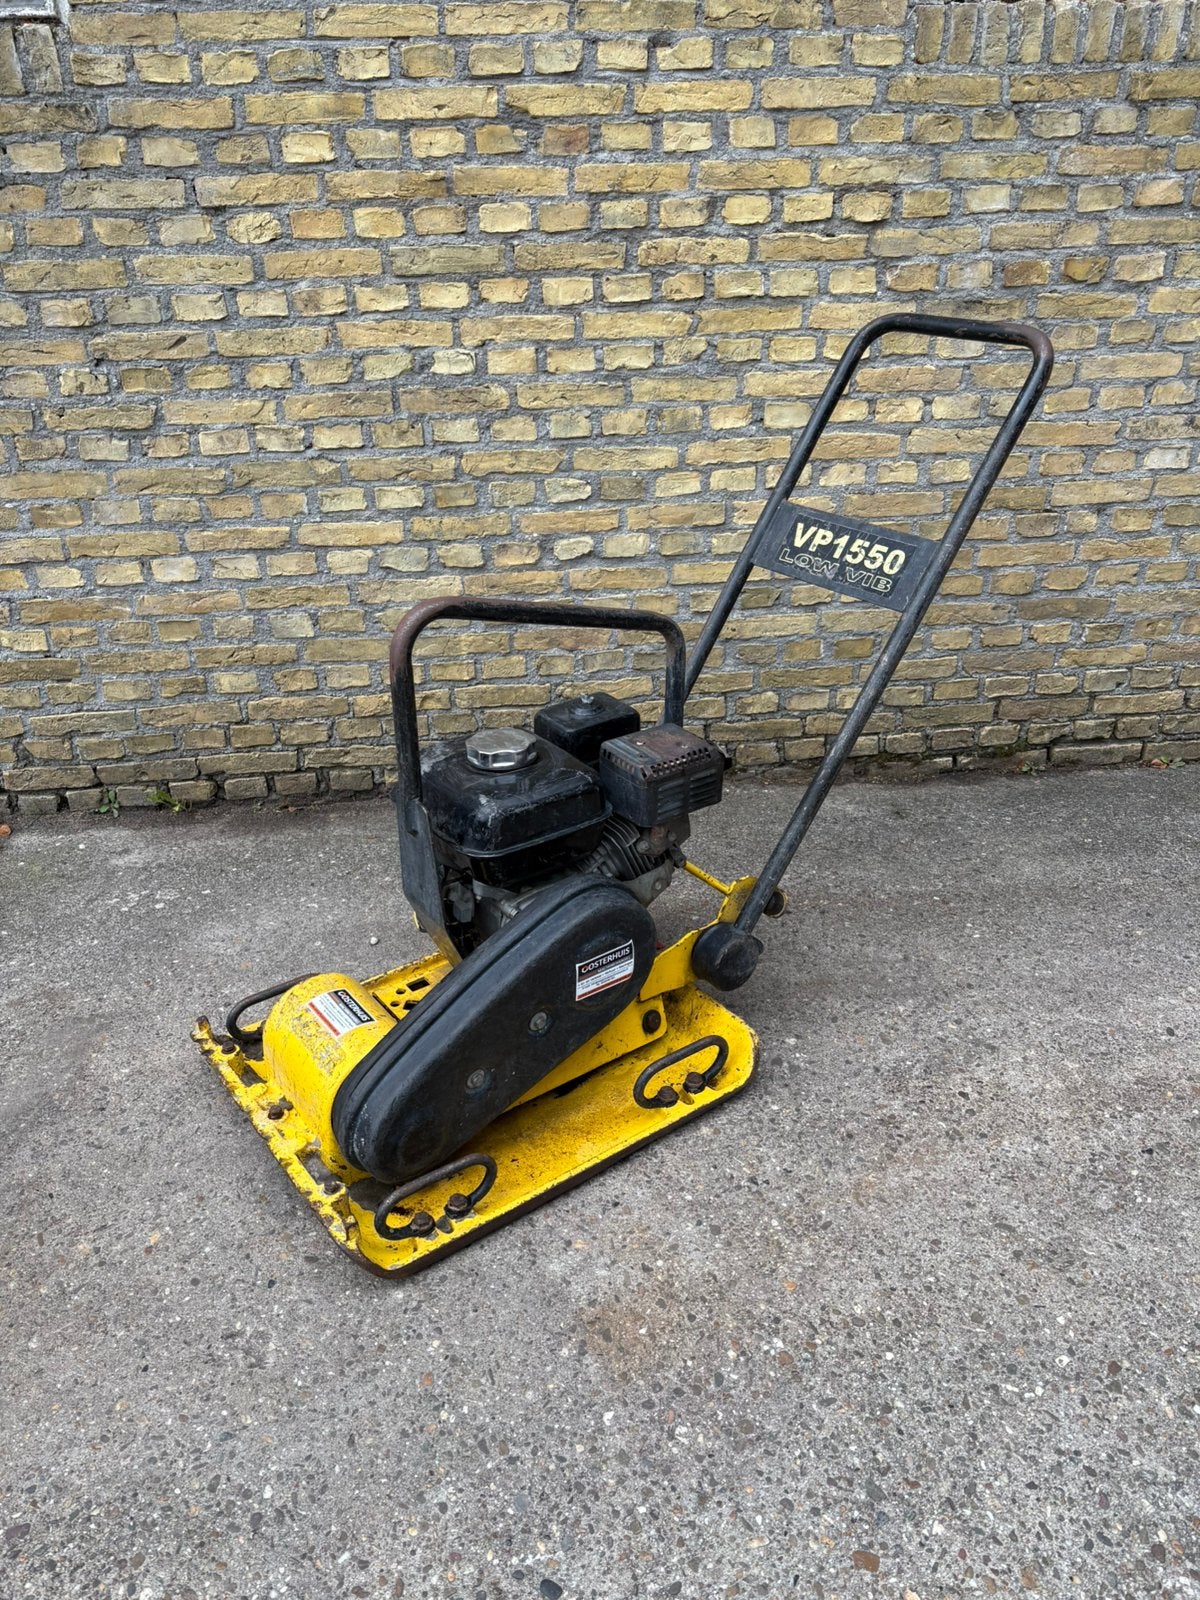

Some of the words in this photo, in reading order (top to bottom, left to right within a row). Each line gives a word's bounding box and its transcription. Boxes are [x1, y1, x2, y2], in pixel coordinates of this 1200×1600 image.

[793, 522, 906, 575] VP1550
[779, 548, 840, 578] LOW
[845, 567, 893, 593] VIB
[581, 946, 630, 973] OSTERHUIS
[337, 991, 371, 1021] OSTERHUIS
